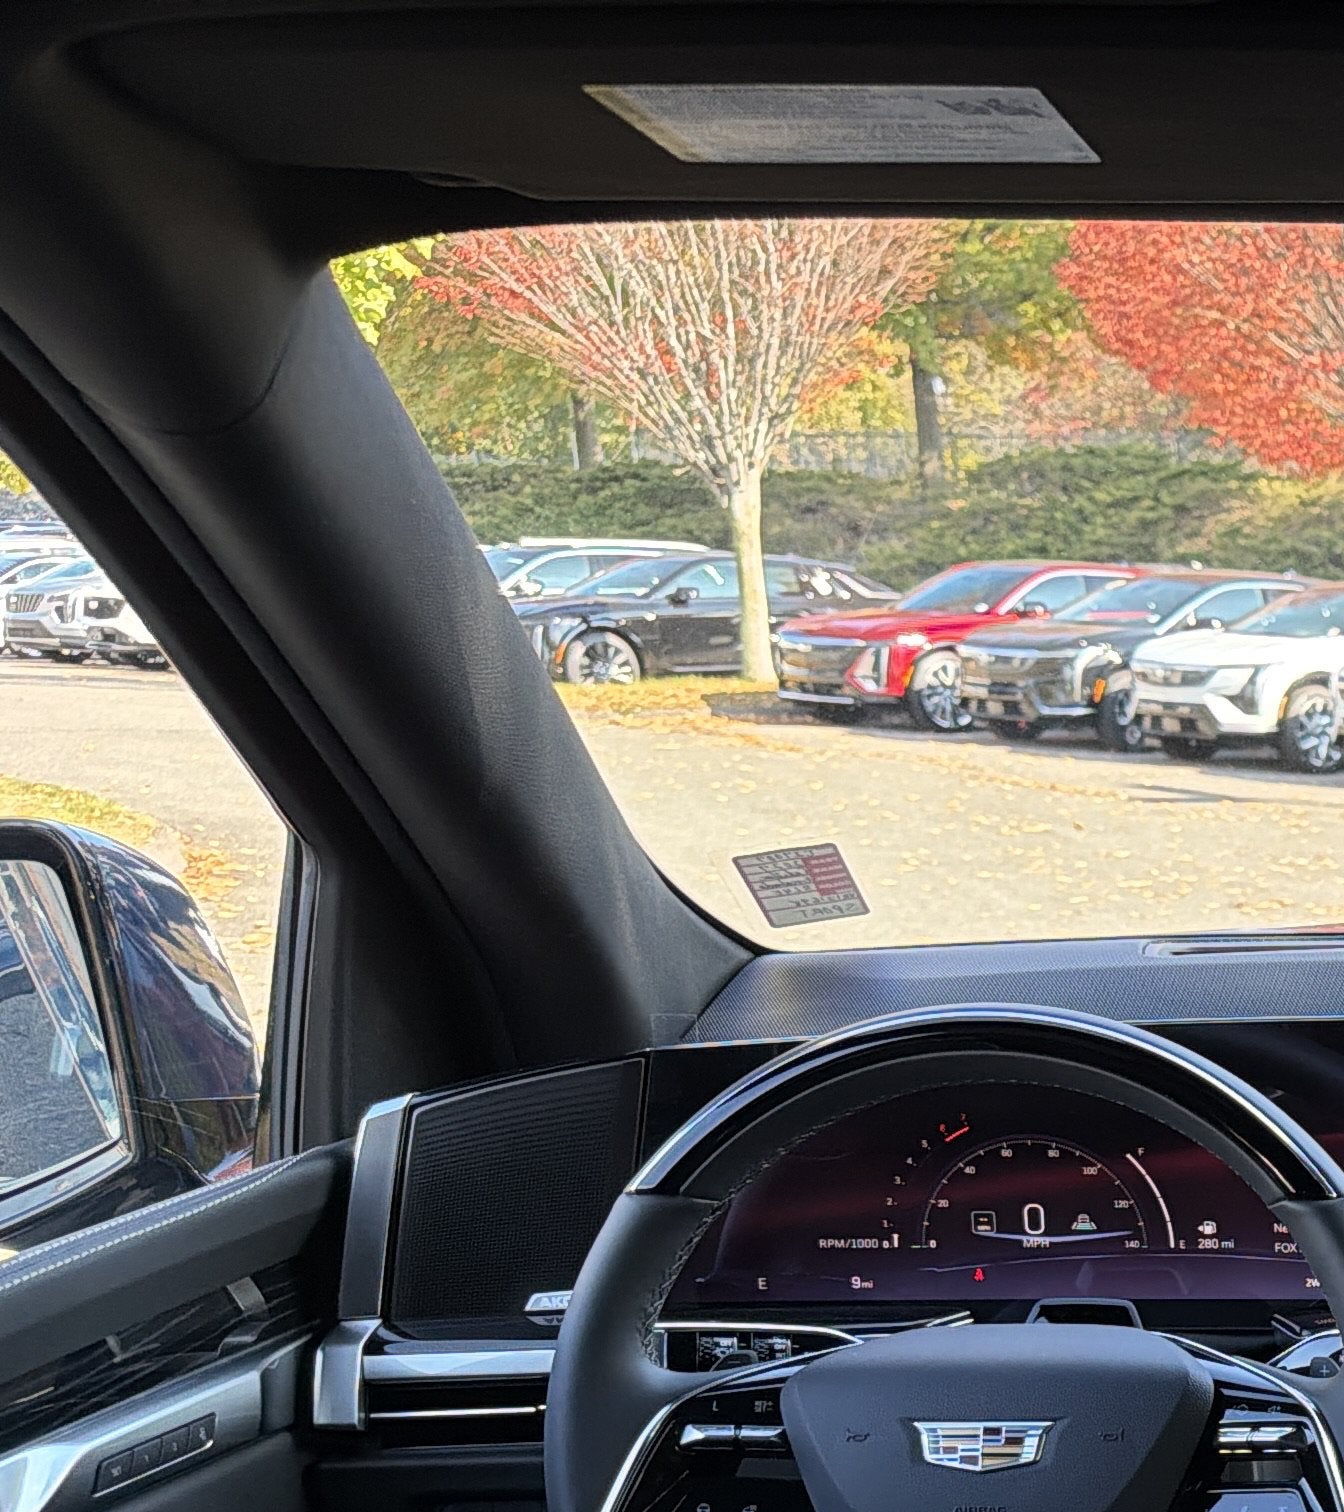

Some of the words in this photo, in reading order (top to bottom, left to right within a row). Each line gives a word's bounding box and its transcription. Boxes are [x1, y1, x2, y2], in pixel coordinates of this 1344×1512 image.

[939, 1123, 945, 1131] 6
[1001, 1149, 1013, 1158] 60
[1048, 1149, 1060, 1158] 80
[1138, 1148, 1145, 1157] F
[906, 1157, 913, 1165] 4
[963, 1166, 976, 1175] 40
[1082, 1166, 1098, 1175] 100
[886, 1198, 893, 1206] 2
[937, 1199, 950, 1208] 20
[1114, 1200, 1129, 1209] 120
[1023, 1203, 1045, 1235] 0
[883, 1220, 889, 1228] 1
[819, 1239, 879, 1248] RPM/1000
[883, 1240, 889, 1248] 0
[930, 1240, 937, 1248] 0
[1023, 1239, 1049, 1248] MPH
[1125, 1241, 1140, 1249] 140
[1180, 1241, 1186, 1249] E
[1198, 1239, 1219, 1249] 280
[1221, 1239, 1235, 1249] mi
[1274, 1243, 1297, 1253] FOX
[758, 1277, 768, 1289] E
